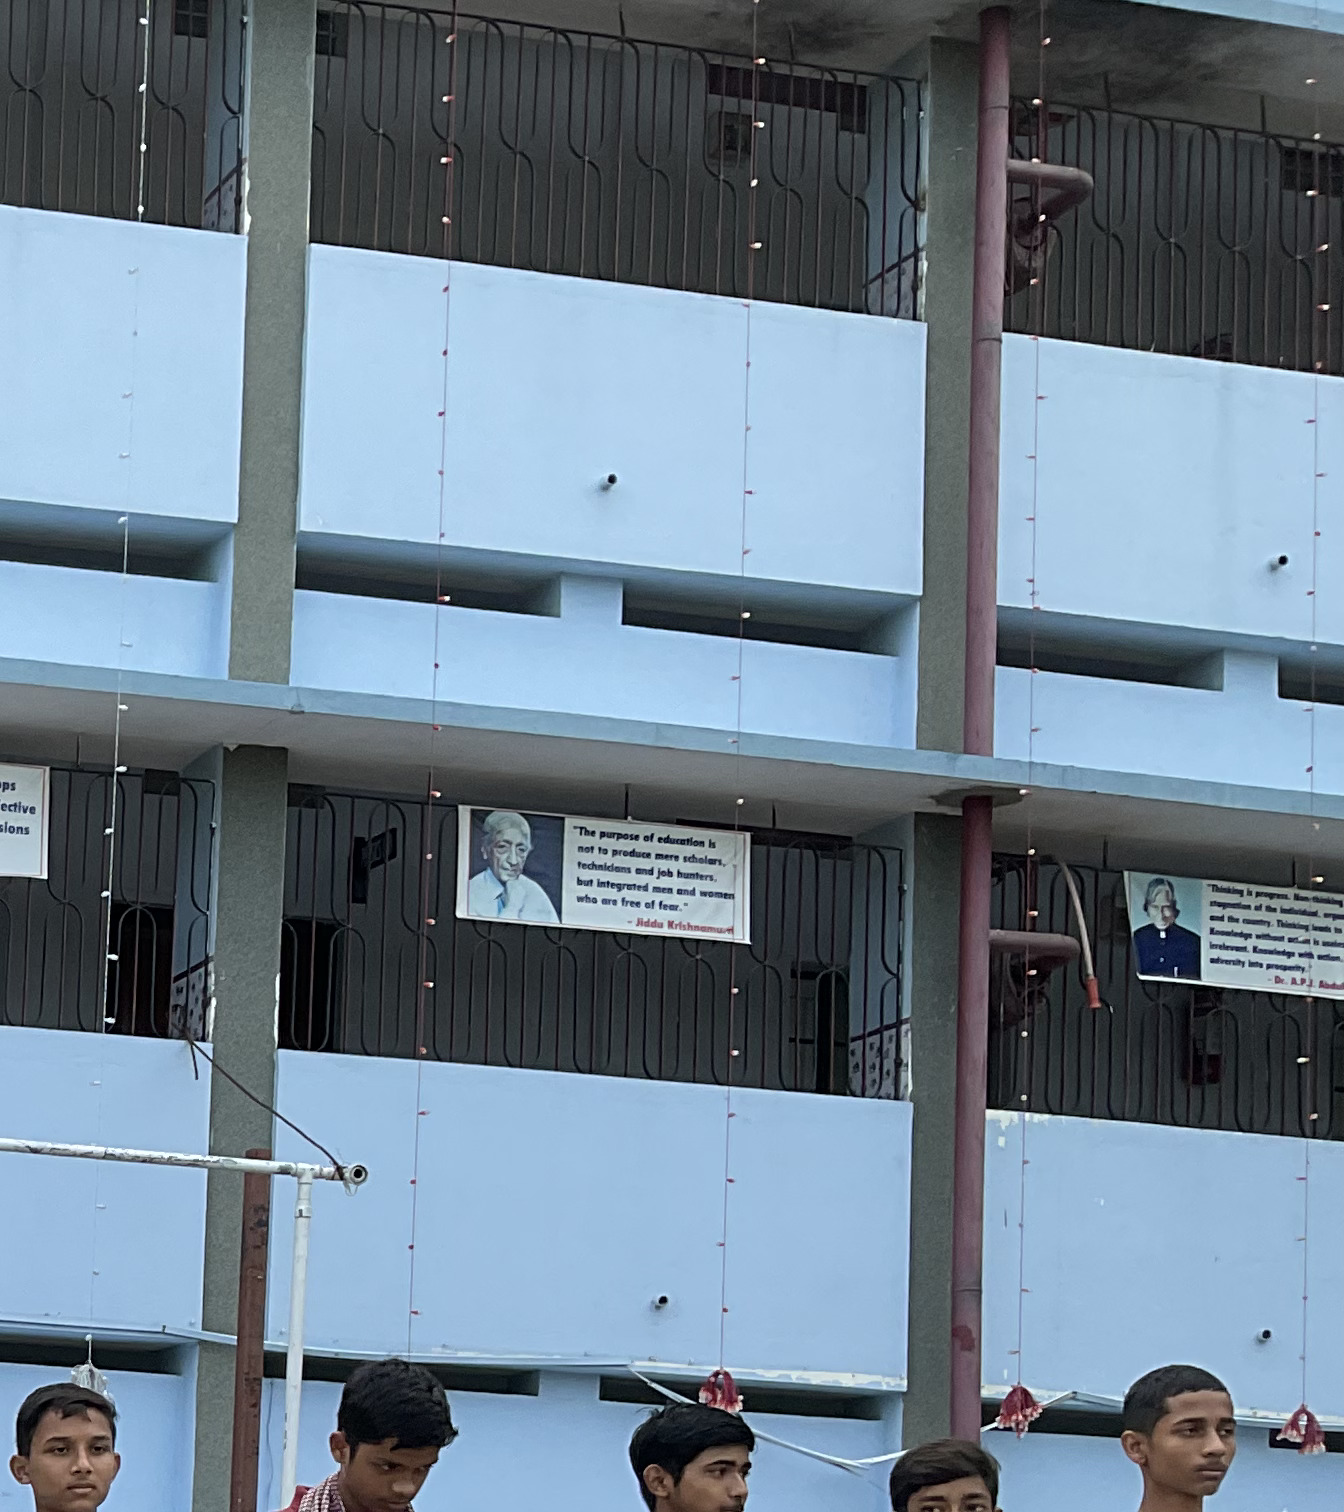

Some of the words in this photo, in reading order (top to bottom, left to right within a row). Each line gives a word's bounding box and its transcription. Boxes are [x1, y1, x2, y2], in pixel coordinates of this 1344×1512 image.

[600, 831, 640, 842] purpose
[643, 833, 654, 842] of
[658, 834, 705, 847] education
[708, 839, 716, 848] is
